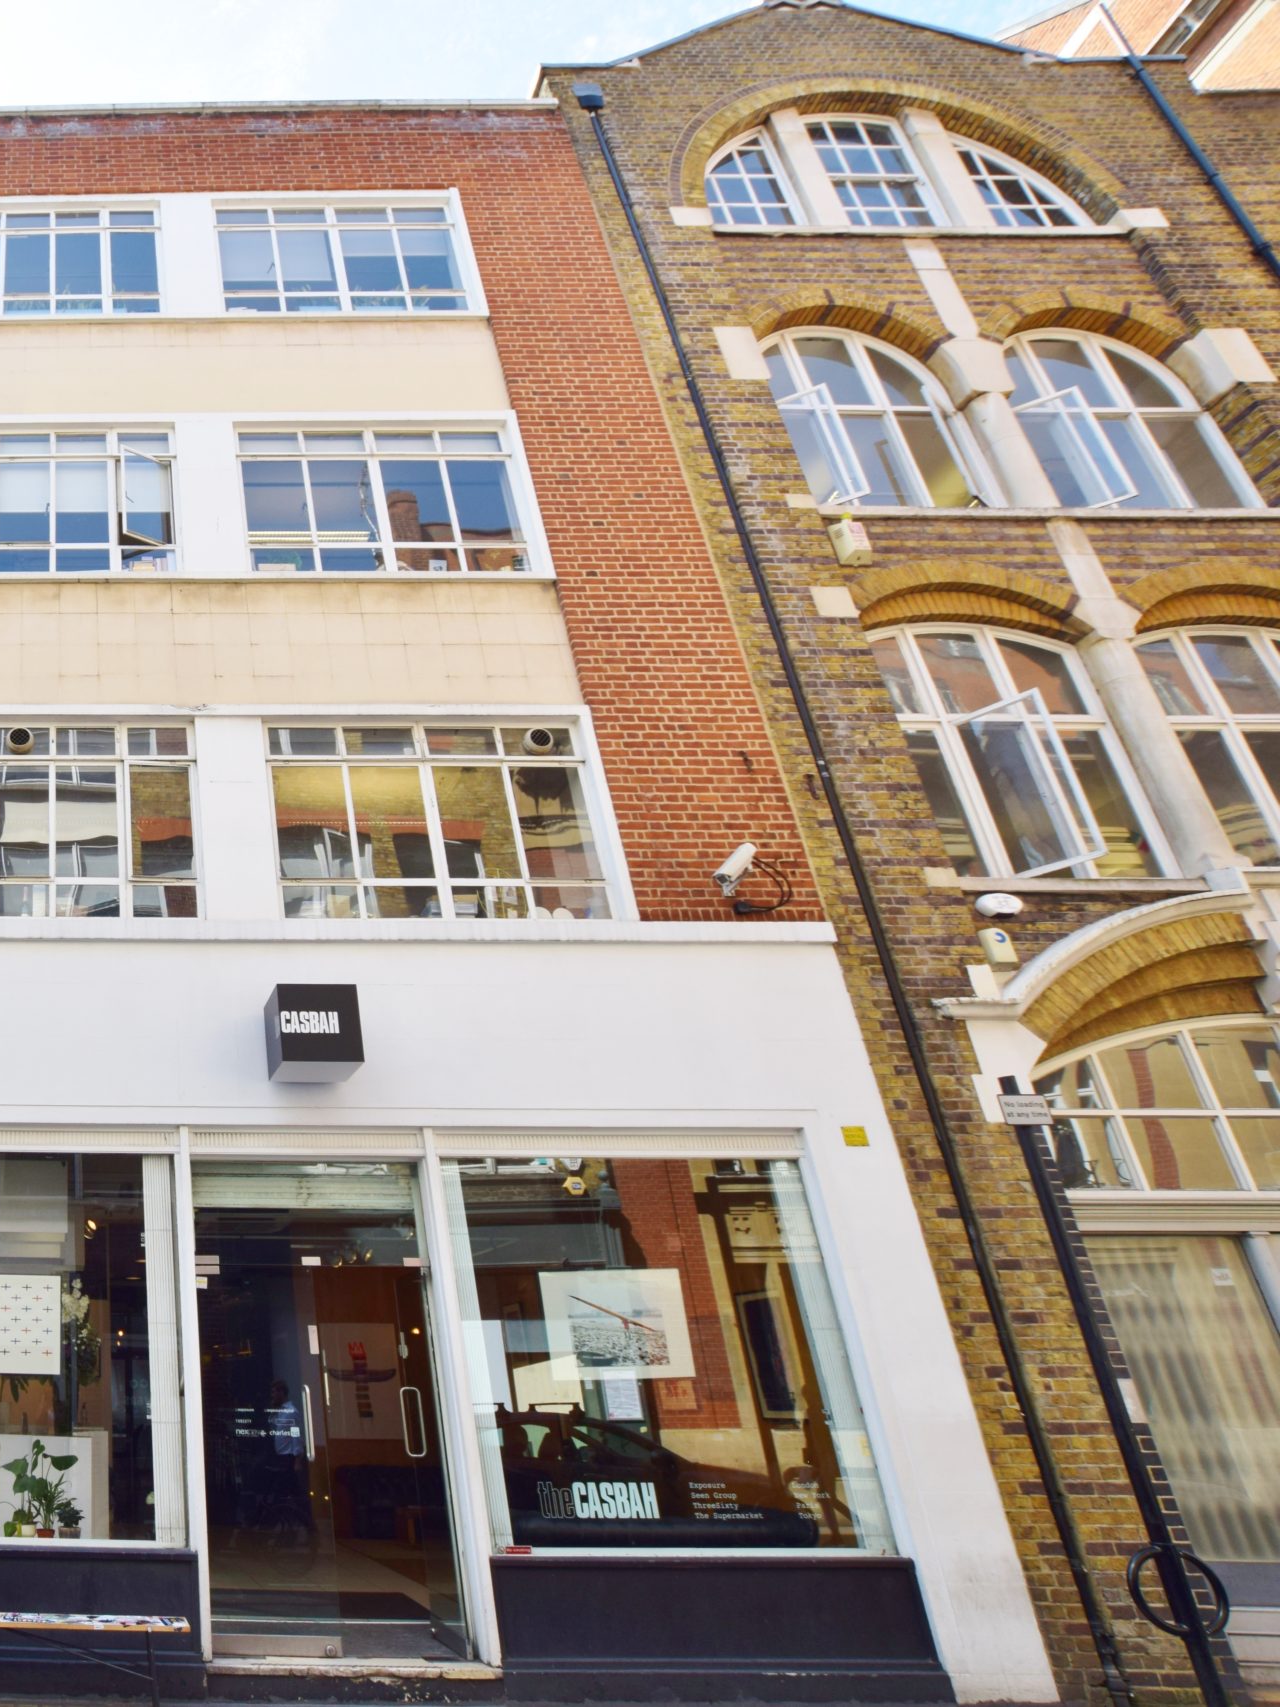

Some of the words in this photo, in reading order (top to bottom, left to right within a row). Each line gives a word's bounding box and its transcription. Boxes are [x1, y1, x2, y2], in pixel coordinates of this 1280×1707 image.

[280, 1011, 340, 1034] CASBAH
[688, 1482, 726, 1490] Exposure
[713, 1492, 737, 1500] Group
[692, 1502, 739, 1510] ThreeSixty
[713, 1512, 764, 1521] Supermarket
[798, 1512, 823, 1520] Tokyo
